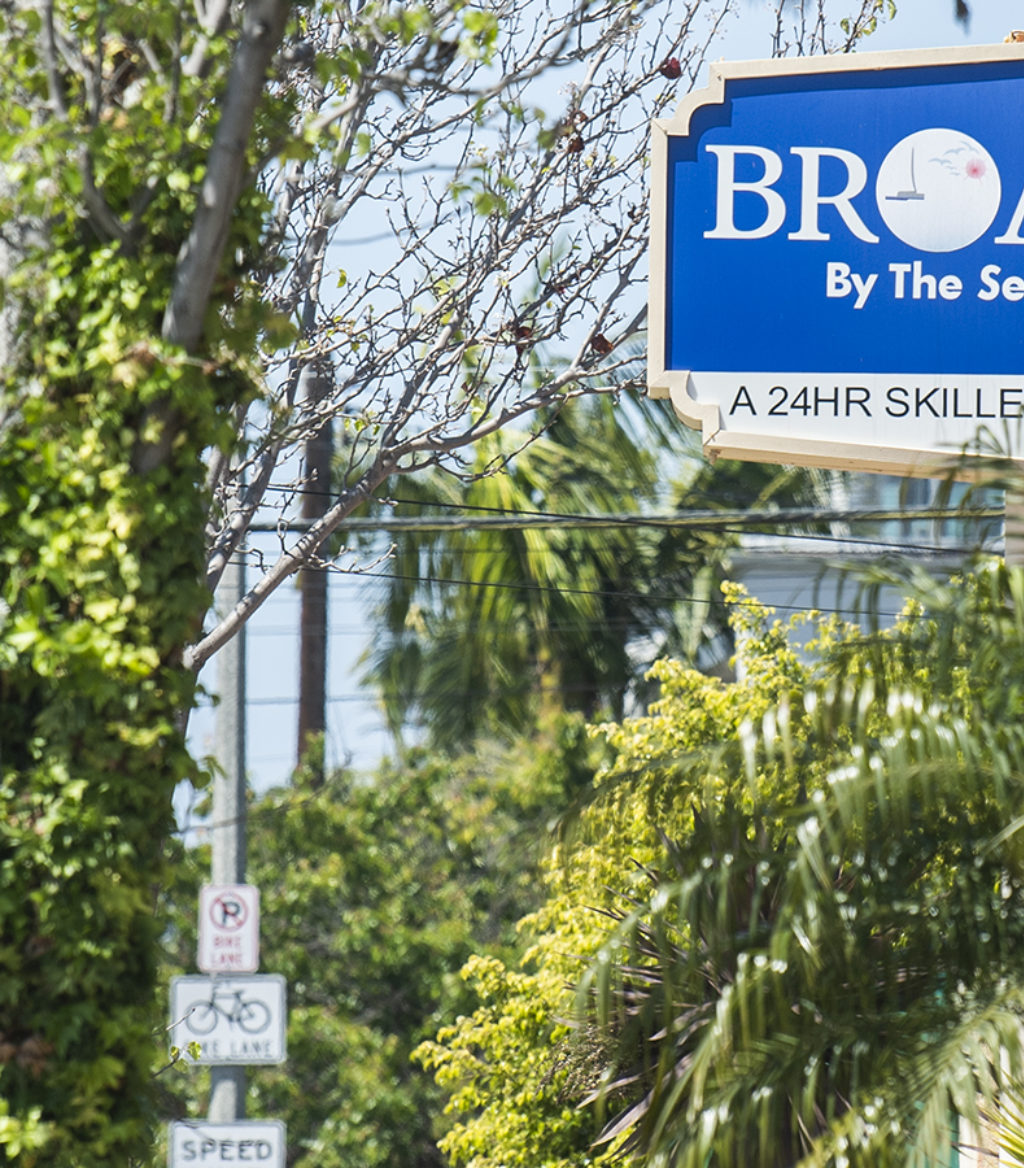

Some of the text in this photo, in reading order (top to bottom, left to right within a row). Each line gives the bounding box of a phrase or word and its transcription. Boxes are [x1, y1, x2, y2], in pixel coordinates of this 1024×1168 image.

[825, 261, 878, 309] By
[888, 260, 963, 301] The
[729, 385, 757, 417] A
[768, 385, 872, 418] 24HR
[181, 1139, 273, 1162] SPEED
